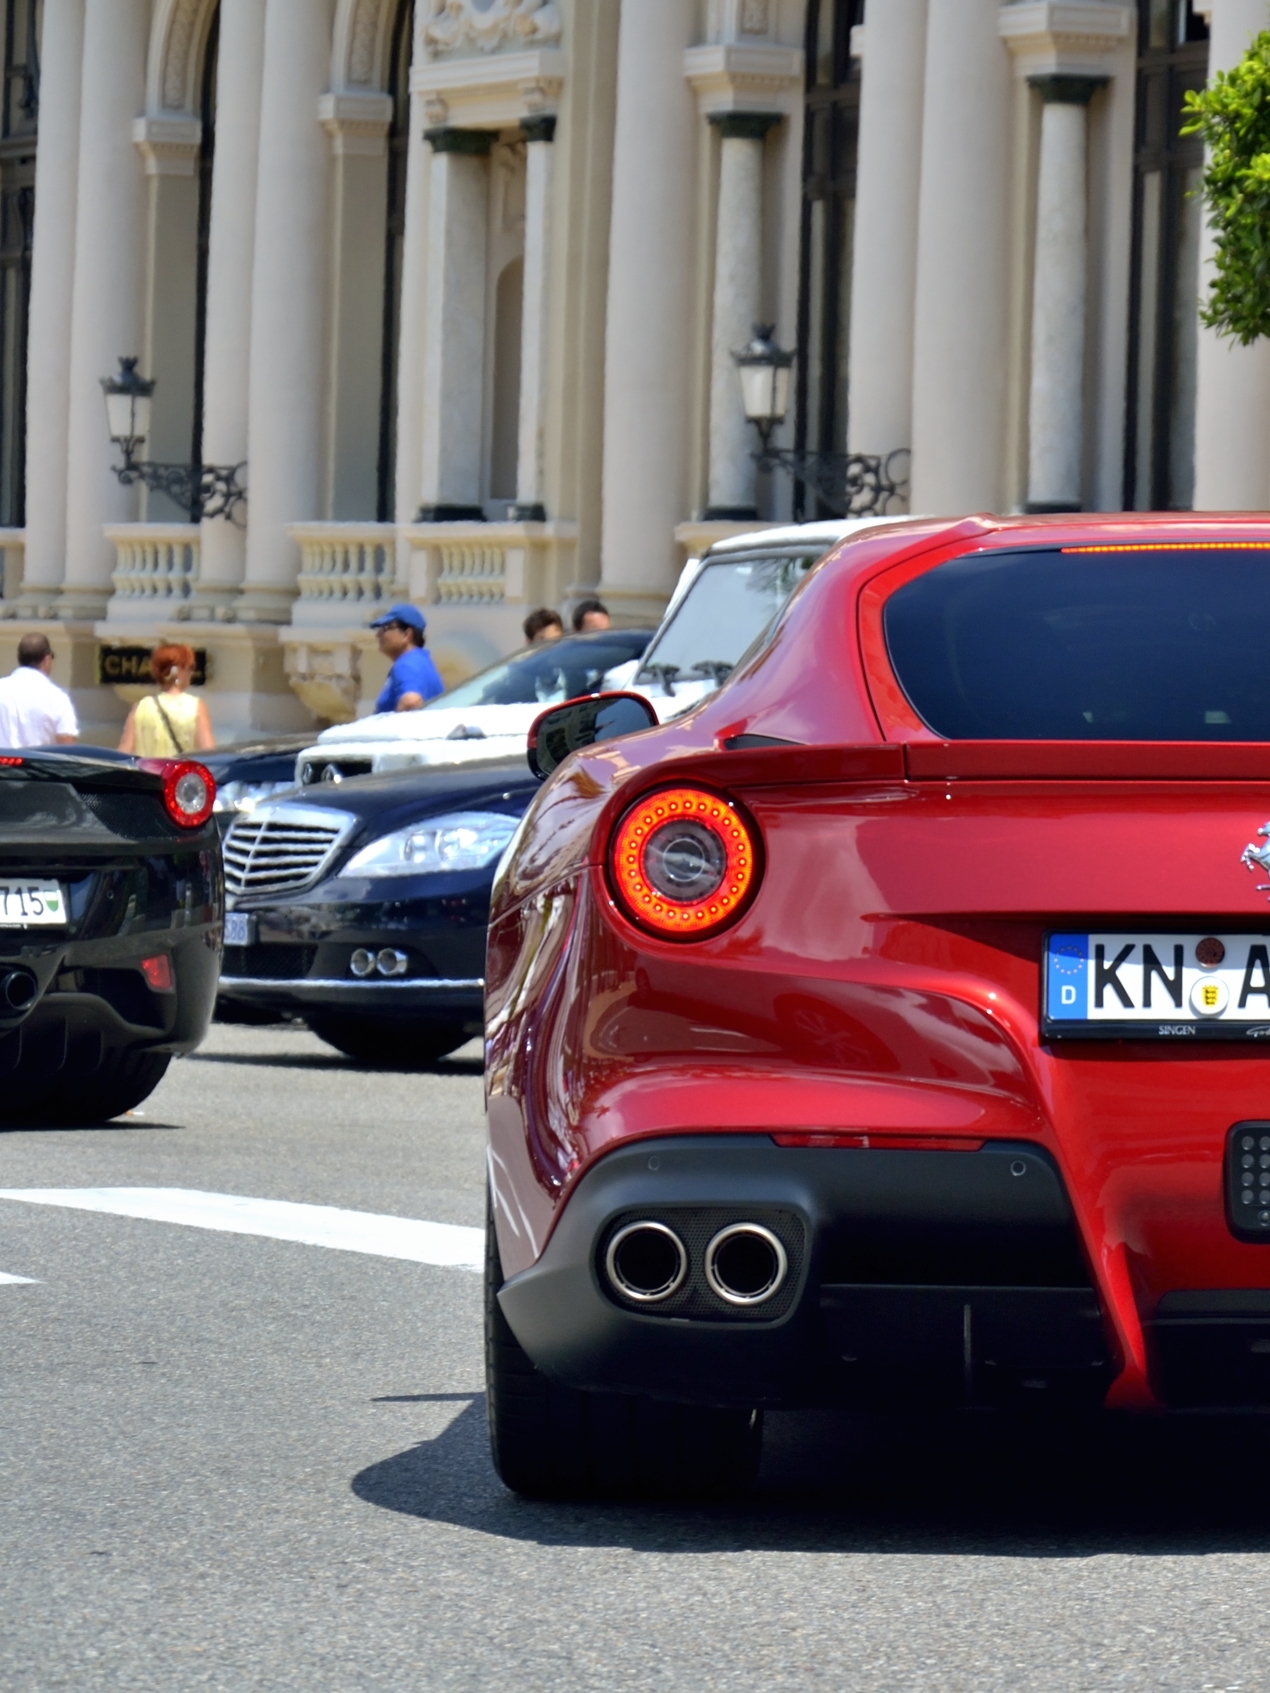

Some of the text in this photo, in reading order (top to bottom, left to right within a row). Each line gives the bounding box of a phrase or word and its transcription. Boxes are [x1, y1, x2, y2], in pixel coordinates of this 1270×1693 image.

[1094, 943, 1184, 1009] KN
[1061, 985, 1077, 1004] D
[1158, 1025, 1196, 1035] SINGEN
